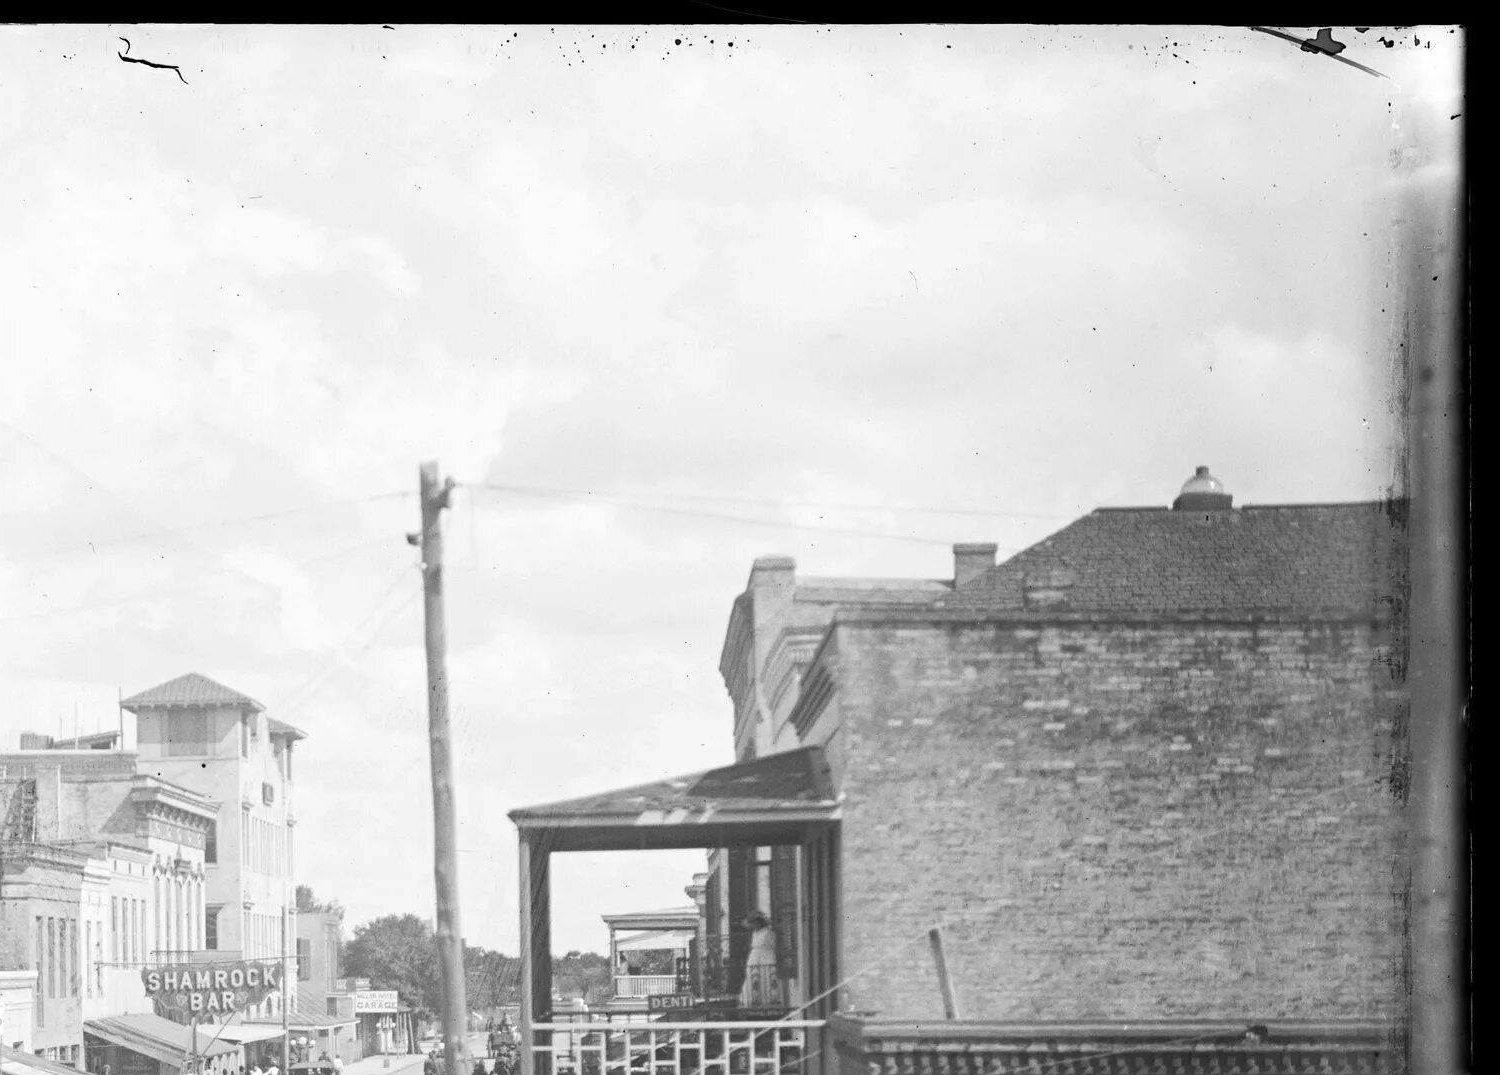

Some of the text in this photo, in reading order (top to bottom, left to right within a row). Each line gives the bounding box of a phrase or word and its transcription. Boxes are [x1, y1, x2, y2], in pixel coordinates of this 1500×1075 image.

[147, 967, 276, 991] SHAMROCK
[190, 991, 236, 1011] BAR
[356, 1001, 397, 1009] GARAGE
